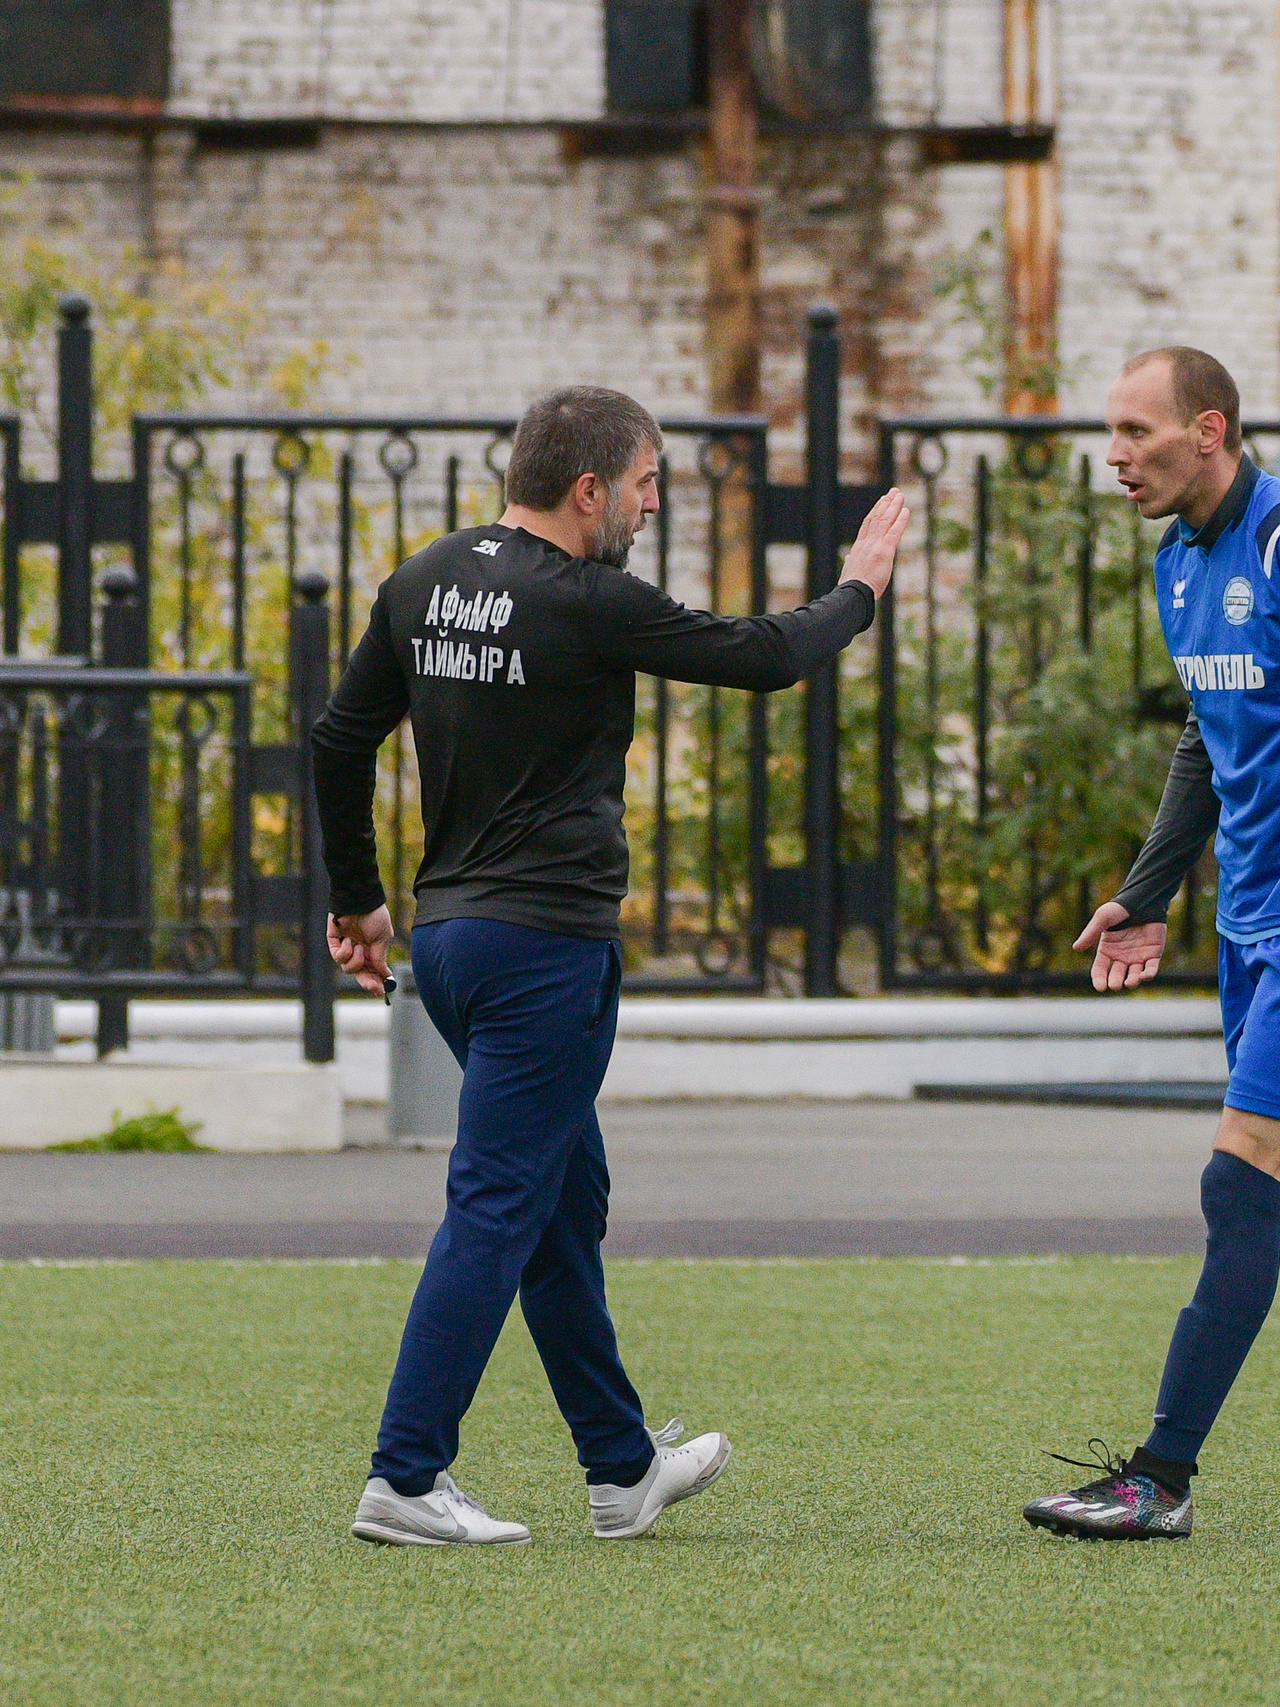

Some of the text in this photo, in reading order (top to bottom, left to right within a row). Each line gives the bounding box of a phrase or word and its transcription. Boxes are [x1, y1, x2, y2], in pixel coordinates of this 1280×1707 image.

[471, 539, 503, 557] 2K
[424, 584, 514, 634] АФиМФ
[411, 628, 526, 685] ТАЙМЫРА
